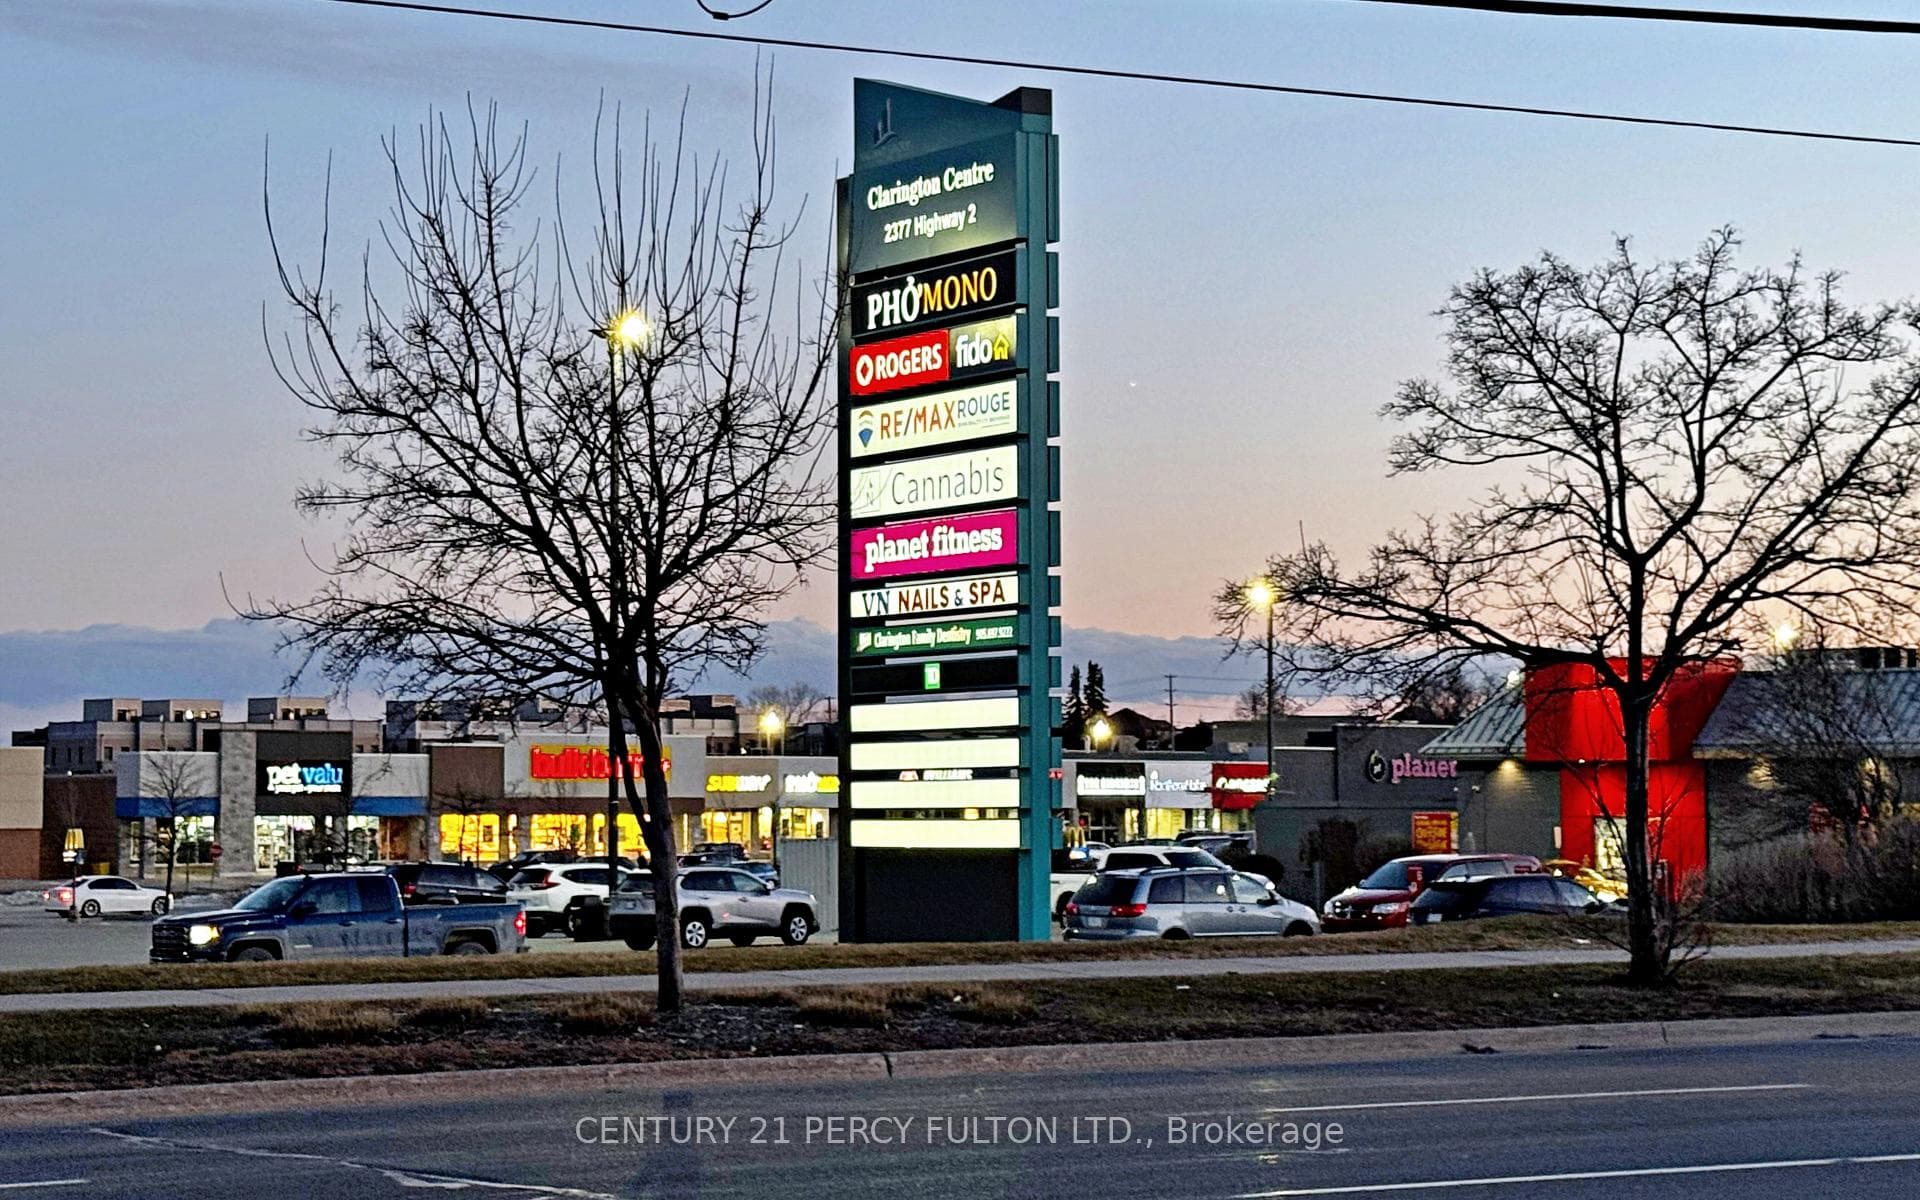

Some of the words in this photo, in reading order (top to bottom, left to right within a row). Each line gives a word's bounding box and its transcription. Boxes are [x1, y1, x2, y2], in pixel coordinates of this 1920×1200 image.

[867, 176, 941, 211] Clarington
[943, 161, 995, 192] Centre
[884, 219, 912, 244] 2377
[914, 211, 966, 238] Highway
[967, 203, 977, 224] 2
[875, 343, 943, 380] ROGERS
[956, 332, 993, 368] fido
[880, 400, 956, 440] RE/MAX
[957, 391, 1011, 419] ROUGE
[891, 457, 1004, 505] Cannabis
[864, 532, 929, 573] planet
[931, 525, 1003, 557] fitness
[862, 591, 890, 617] VN
[898, 586, 949, 612] NAILS
[954, 589, 963, 607] &
[969, 580, 1006, 605] SPA
[266, 762, 302, 791] pet
[303, 763, 343, 784] valu
